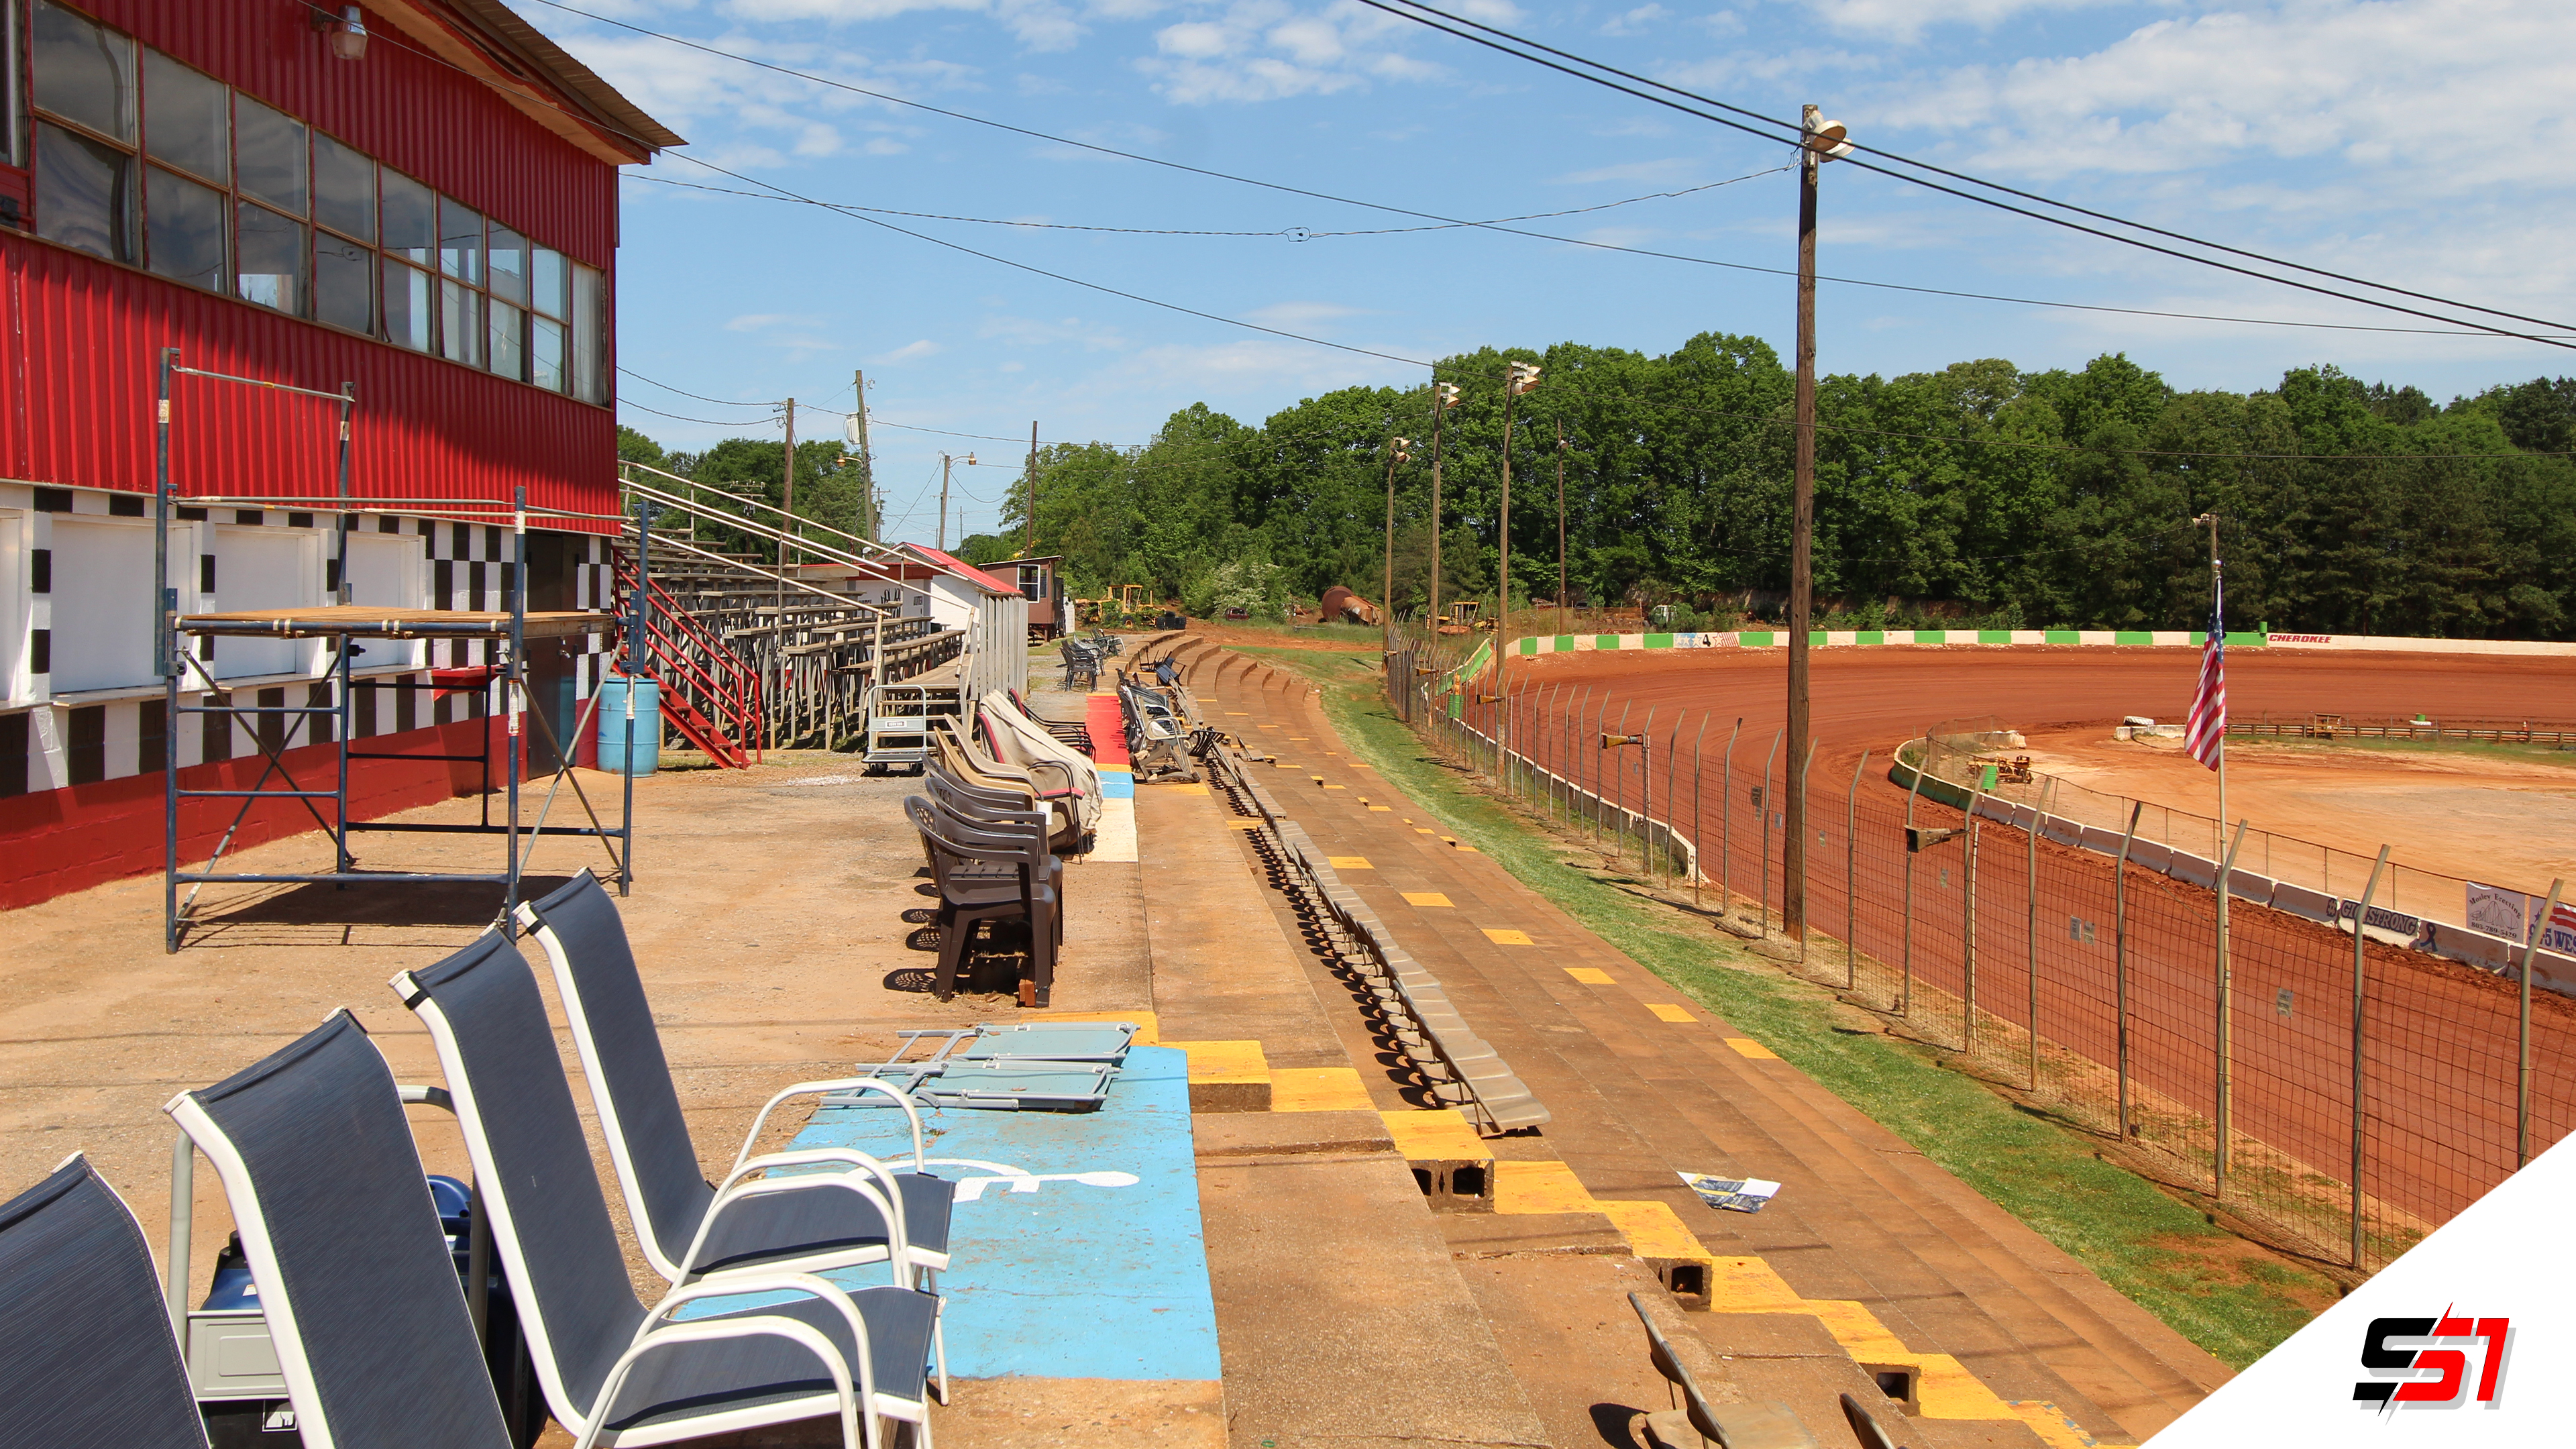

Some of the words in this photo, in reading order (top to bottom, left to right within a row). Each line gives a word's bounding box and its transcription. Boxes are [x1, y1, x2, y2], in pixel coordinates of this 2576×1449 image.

[1703, 634, 1711, 647] 4
[2269, 635, 2332, 643] CHEROKEE
[2469, 894, 2491, 906] Mosley
[2493, 893, 2522, 919] Erecting
